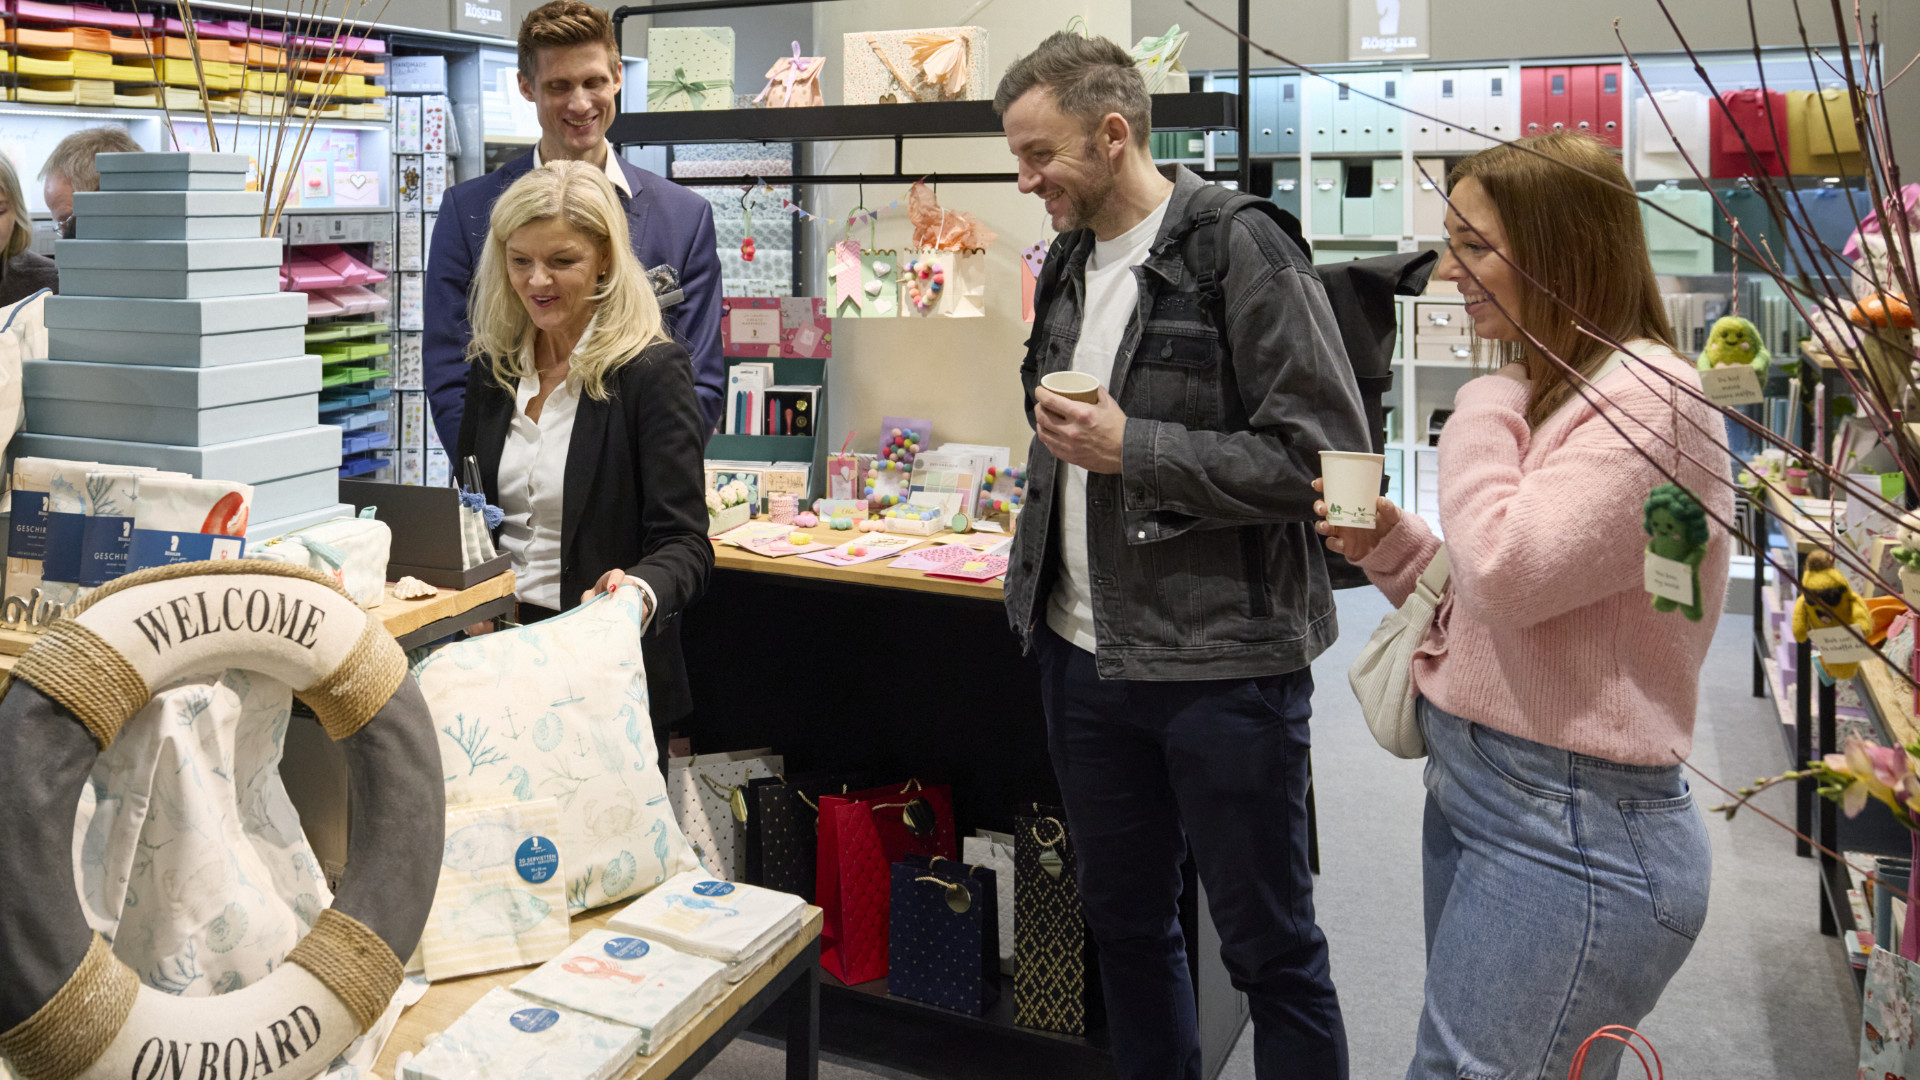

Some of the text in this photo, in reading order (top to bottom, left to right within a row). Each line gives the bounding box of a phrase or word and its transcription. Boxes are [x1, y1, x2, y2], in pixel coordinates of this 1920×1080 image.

[465, 2, 503, 21] RÖSSLER
[1361, 36, 1417, 50] RÖSSLER
[132, 587, 326, 656] WELCOME
[526, 854, 557, 863] SERVIETTEN
[132, 1005, 321, 1080] ON BOARD
